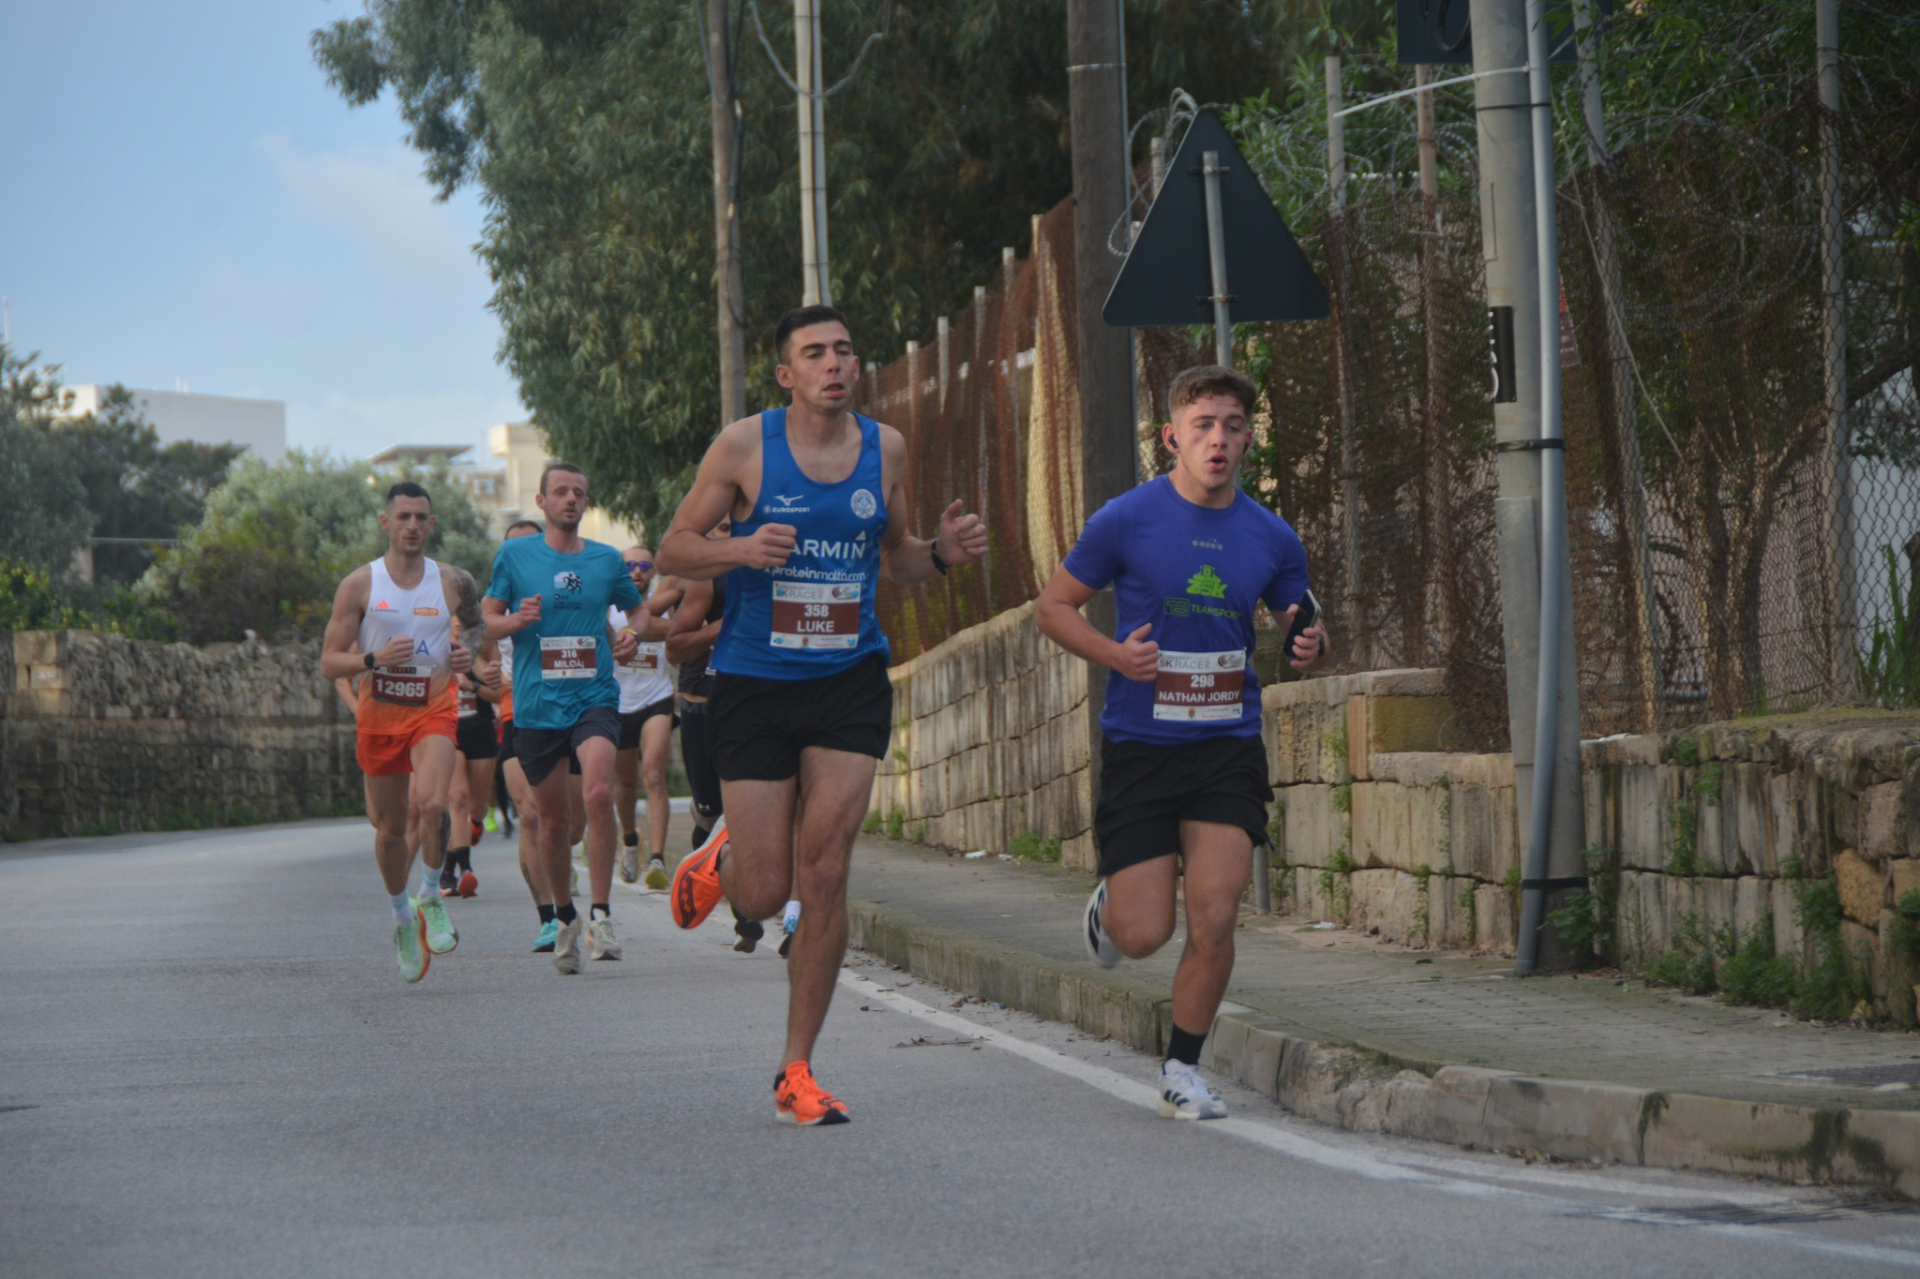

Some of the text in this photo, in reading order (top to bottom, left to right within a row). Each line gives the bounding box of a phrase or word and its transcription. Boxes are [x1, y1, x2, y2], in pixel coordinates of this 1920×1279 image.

[789, 590, 818, 600] RACE
[804, 604, 829, 617] 358
[797, 620, 835, 633] LUKE
[561, 650, 577, 658] 316
[1160, 660, 1173, 668] 5K
[1175, 661, 1204, 669] RACE
[1190, 674, 1215, 687] 298
[376, 679, 426, 697] 12965
[1159, 690, 1240, 702] NATHAN JORDY
